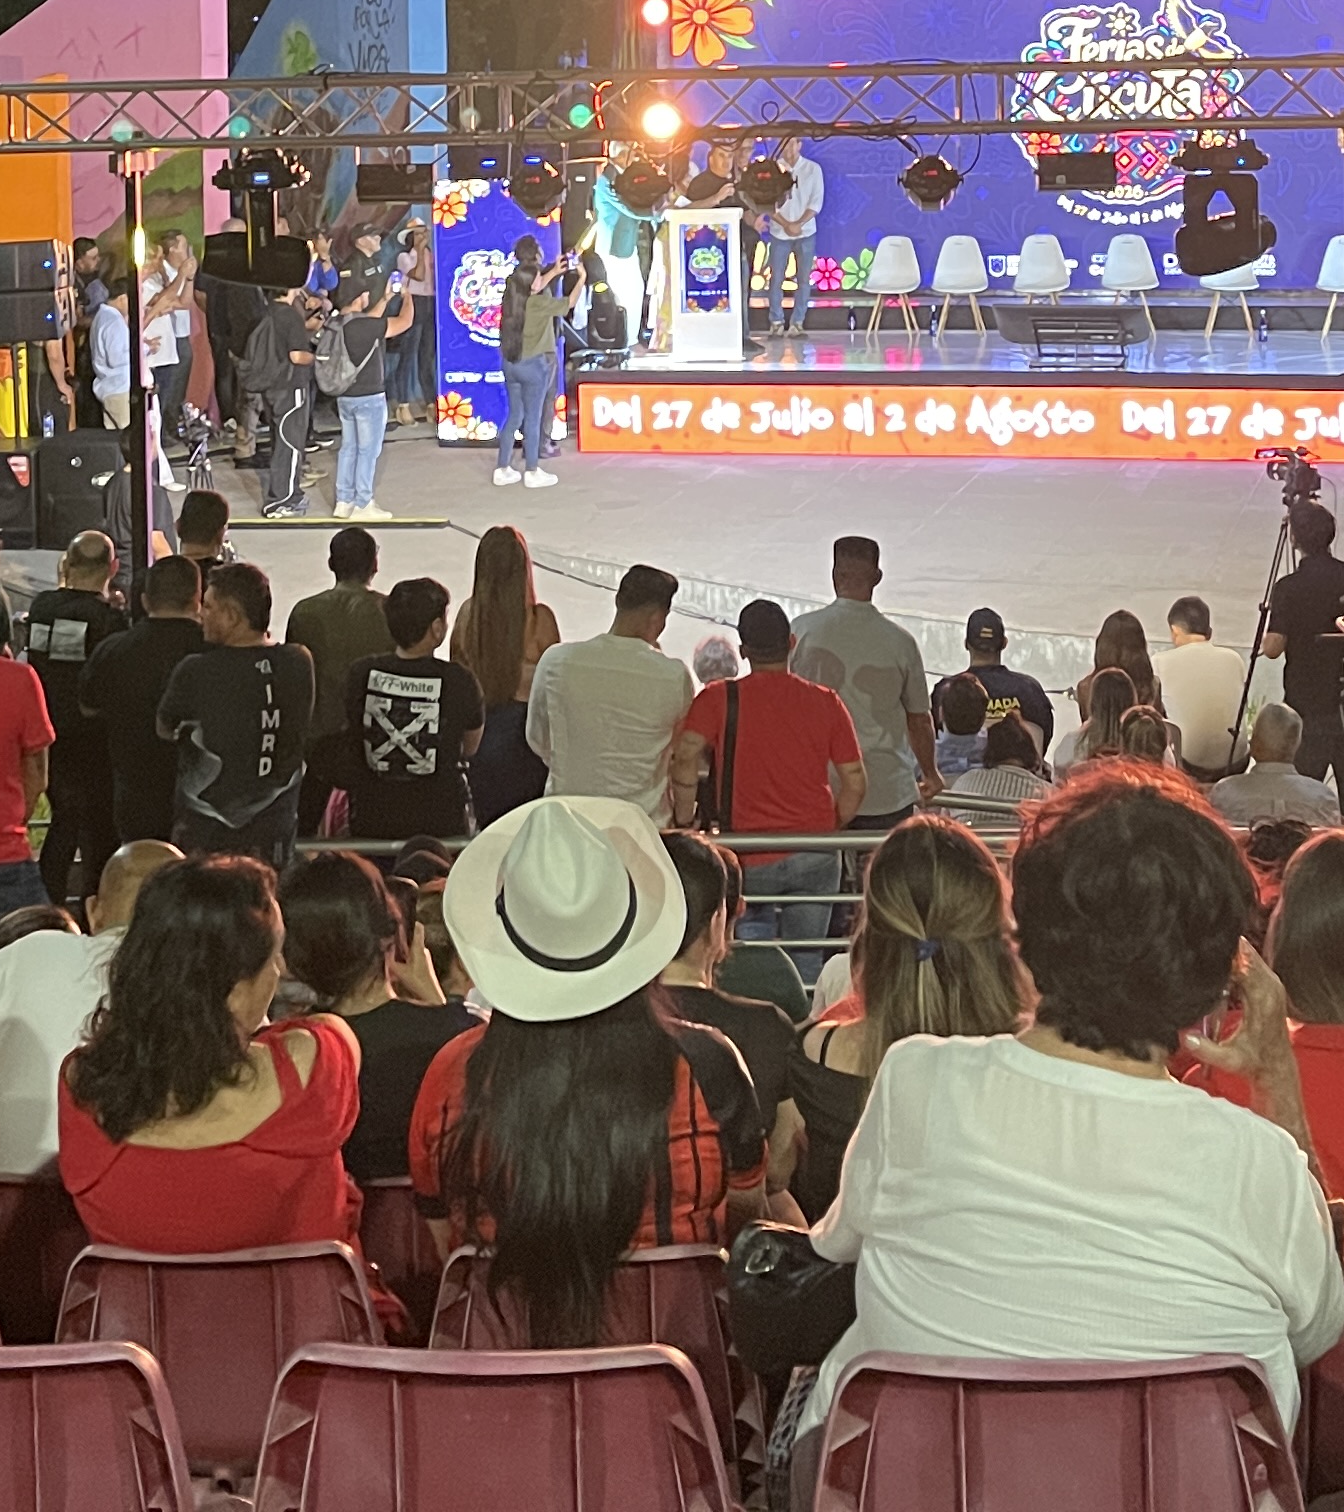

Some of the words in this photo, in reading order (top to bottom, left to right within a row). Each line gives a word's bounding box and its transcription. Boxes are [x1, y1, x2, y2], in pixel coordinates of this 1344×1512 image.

[1047, 15, 1164, 63] Ferias
[592, 394, 643, 435] Del
[651, 400, 694, 431] 27
[700, 396, 742, 434] de
[749, 395, 835, 437] Julio
[842, 396, 875, 437] al
[884, 402, 907, 433] 2
[914, 397, 957, 437] de
[965, 395, 1096, 447] Agosto
[1121, 398, 1176, 441] Del
[1186, 404, 1232, 438] 27
[1240, 401, 1284, 441] de
